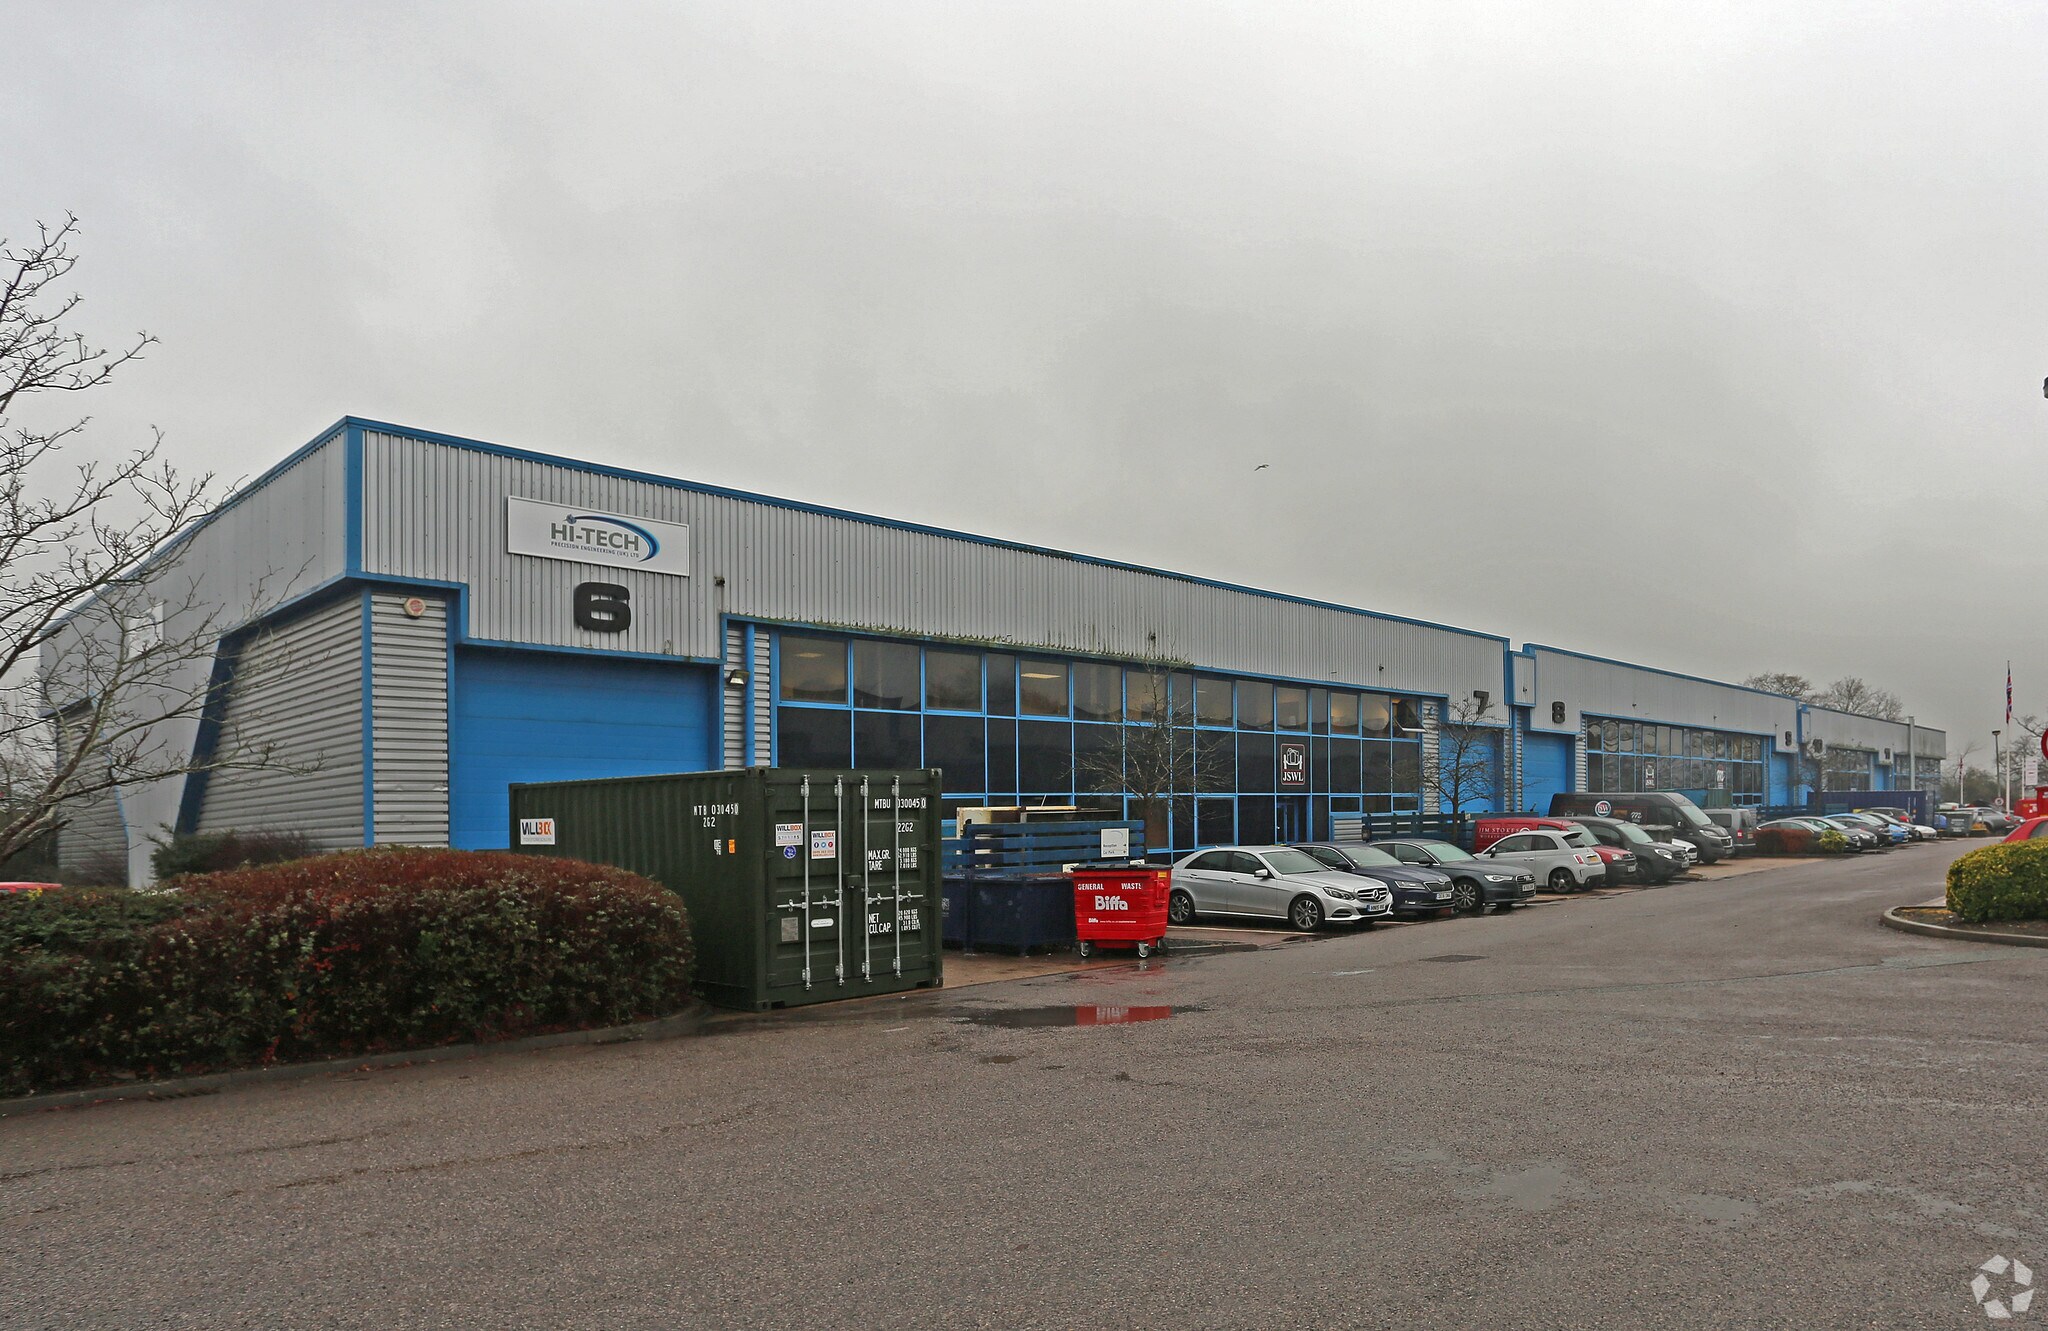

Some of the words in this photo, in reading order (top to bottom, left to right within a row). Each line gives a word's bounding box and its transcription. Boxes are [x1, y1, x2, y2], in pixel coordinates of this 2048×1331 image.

[551, 523, 639, 551] HI-TECH
[551, 541, 579, 549] PRECISION
[581, 545, 615, 555] ENGINEERING
[573, 582, 631, 632] 6
[1474, 690, 1489, 714] 7
[1552, 702, 1565, 724] 8
[1283, 771, 1303, 781] JSWL
[874, 798, 891, 809] MTBU
[897, 822, 914, 833] 22G2
[868, 860, 882, 871] TARE
[1094, 895, 1128, 911] Biffa
[869, 912, 879, 924] NET
